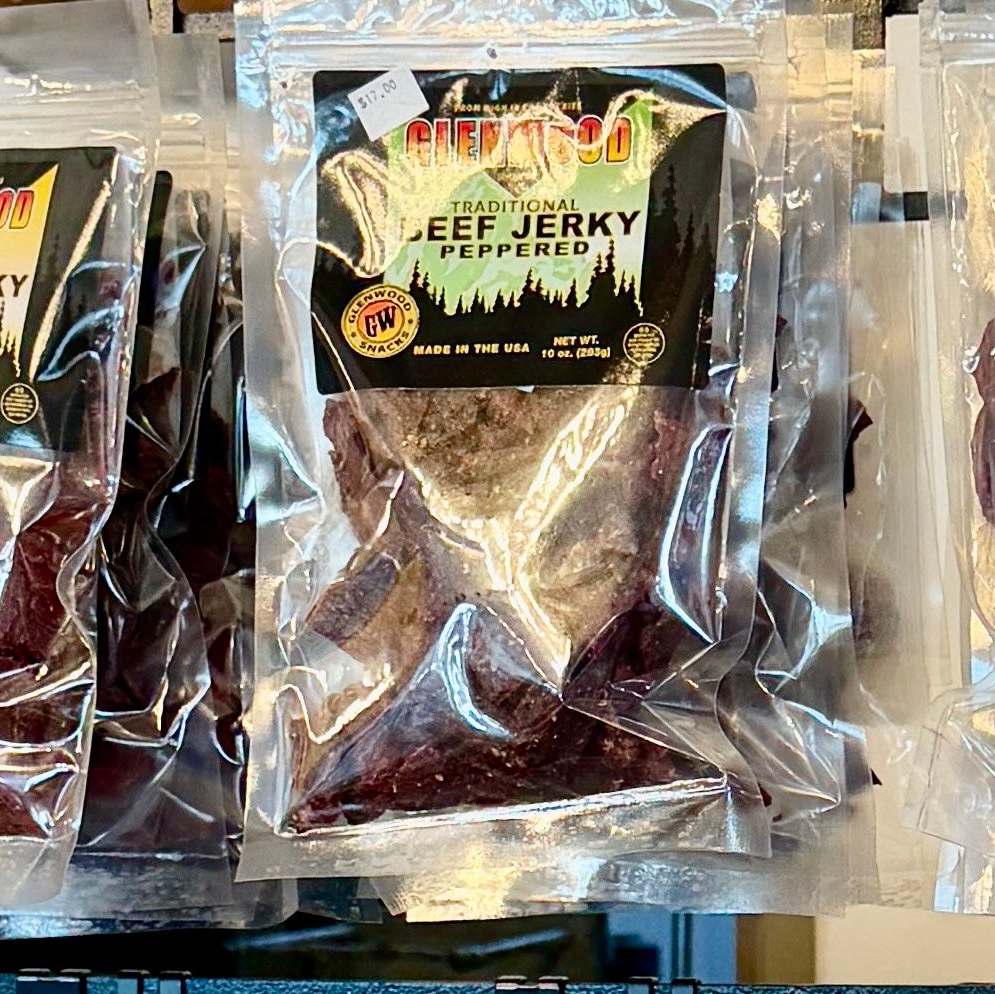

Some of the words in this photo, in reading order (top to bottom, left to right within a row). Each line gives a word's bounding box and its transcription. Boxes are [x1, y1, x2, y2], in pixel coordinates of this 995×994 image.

[358, 79, 397, 109] $17.00
[451, 199, 580, 214] TRADITIONAL
[511, 211, 641, 240] JERKY
[440, 241, 590, 259] PEPPERED
[349, 290, 411, 323] GLENWOOD
[365, 306, 396, 337] GW
[359, 331, 409, 353] SNACKS
[413, 345, 451, 355] MADE
[455, 345, 469, 354] IN
[474, 344, 499, 354] THE
[505, 343, 530, 353] USA
[553, 336, 576, 346] NET
[579, 335, 599, 345] WT.
[542, 349, 554, 358] 10
[557, 350, 573, 358] oz.
